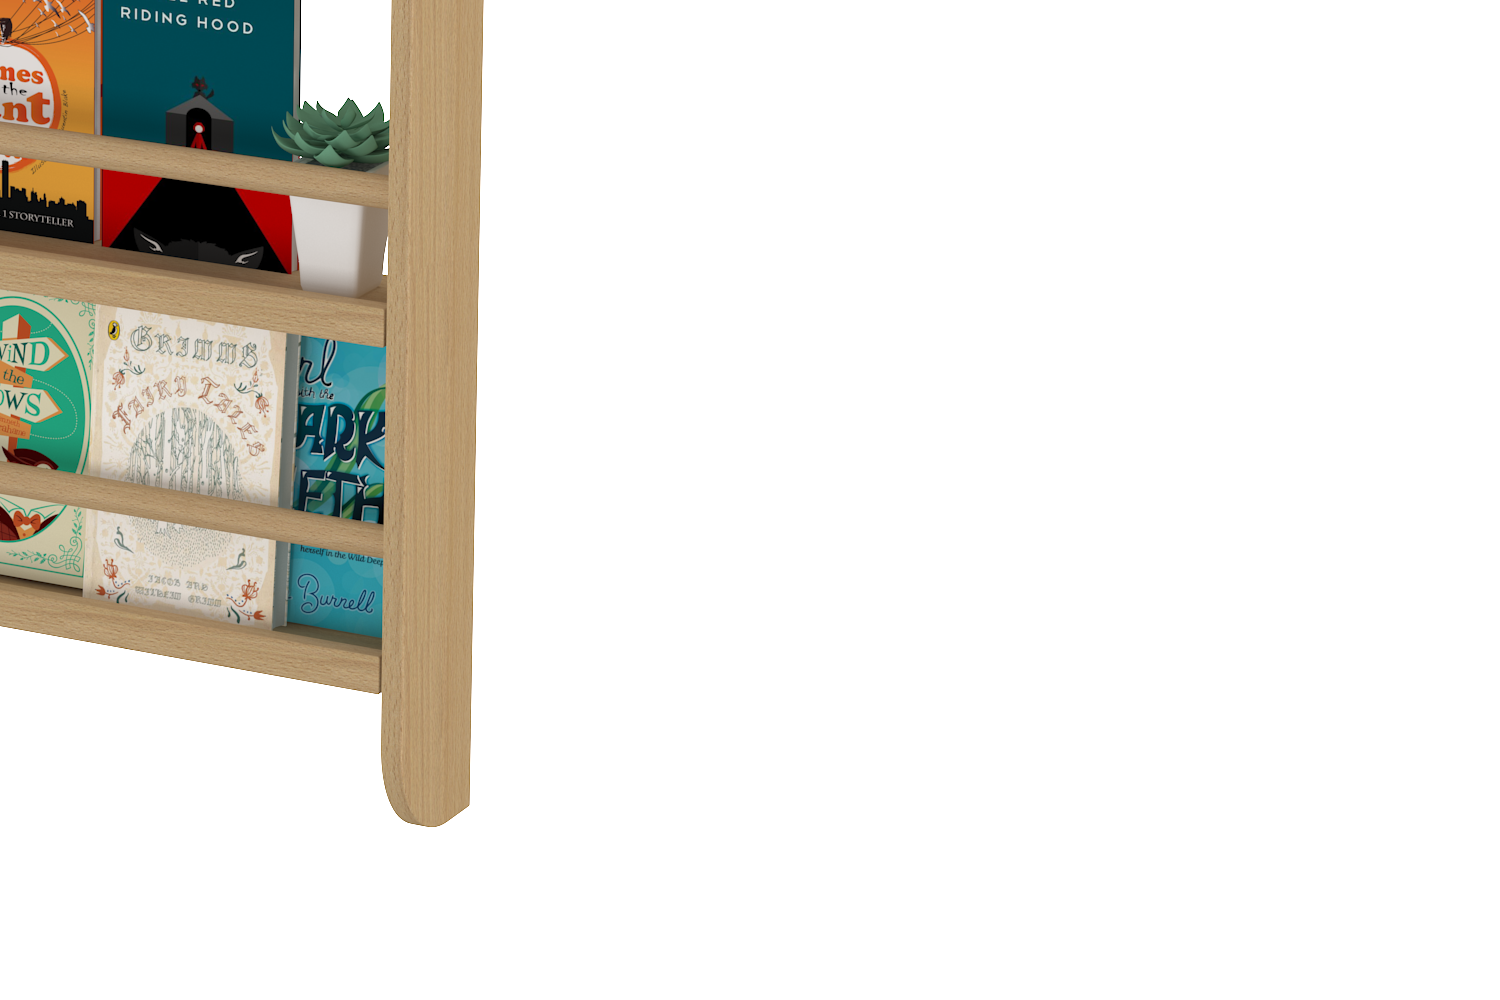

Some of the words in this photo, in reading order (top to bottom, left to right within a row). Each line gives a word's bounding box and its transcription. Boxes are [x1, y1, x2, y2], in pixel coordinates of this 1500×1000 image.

[121, 6, 187, 26] RIDING
[197, 16, 254, 34] HOOD
[1, 82, 28, 97] the
[3, 210, 7, 218] 1
[9, 211, 74, 228] STORYTELLER
[3, 369, 25, 385] the
[319, 389, 335, 400] the
[300, 545, 325, 557] herself
[335, 551, 347, 560] the
[348, 553, 366, 562] Wild
[298, 573, 375, 614] Burrell
